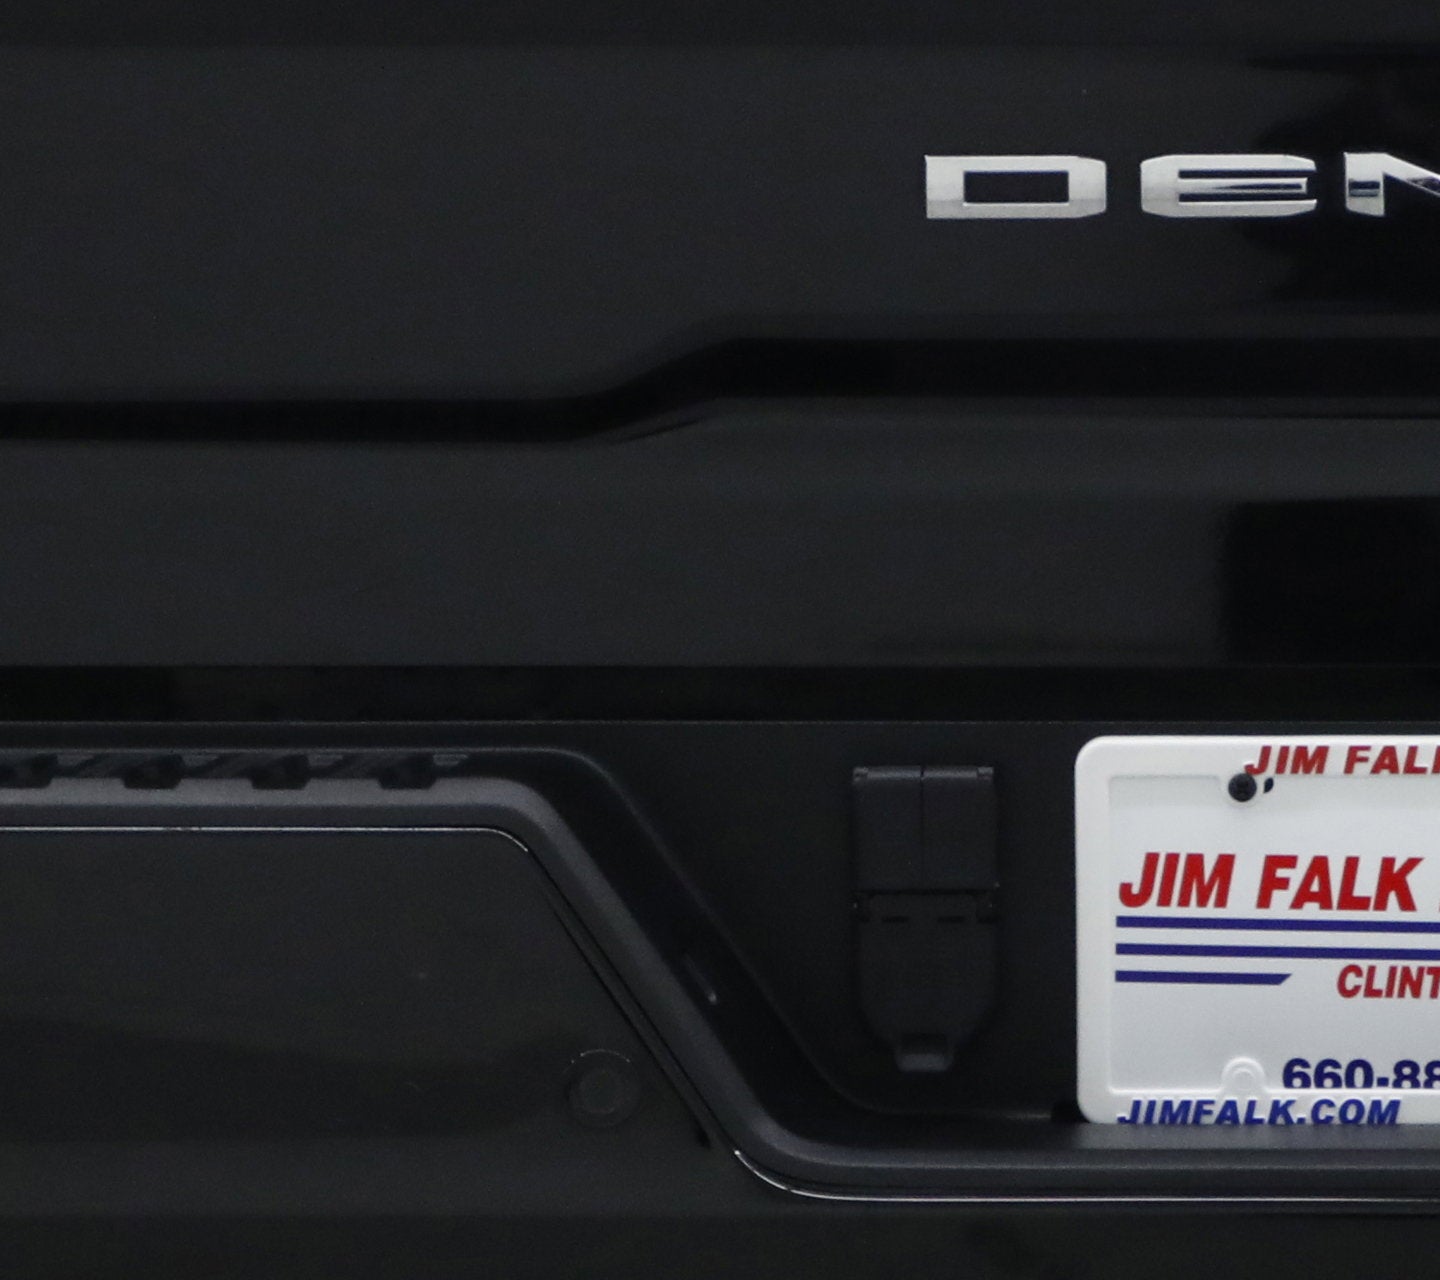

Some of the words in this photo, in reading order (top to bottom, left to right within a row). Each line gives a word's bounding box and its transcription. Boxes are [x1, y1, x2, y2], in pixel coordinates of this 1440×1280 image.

[1245, 745, 1330, 775] JIM
[1118, 852, 1236, 908] JIM
[1255, 855, 1424, 911] FALK
[1117, 1099, 1402, 1124] JIMFALK.COM
